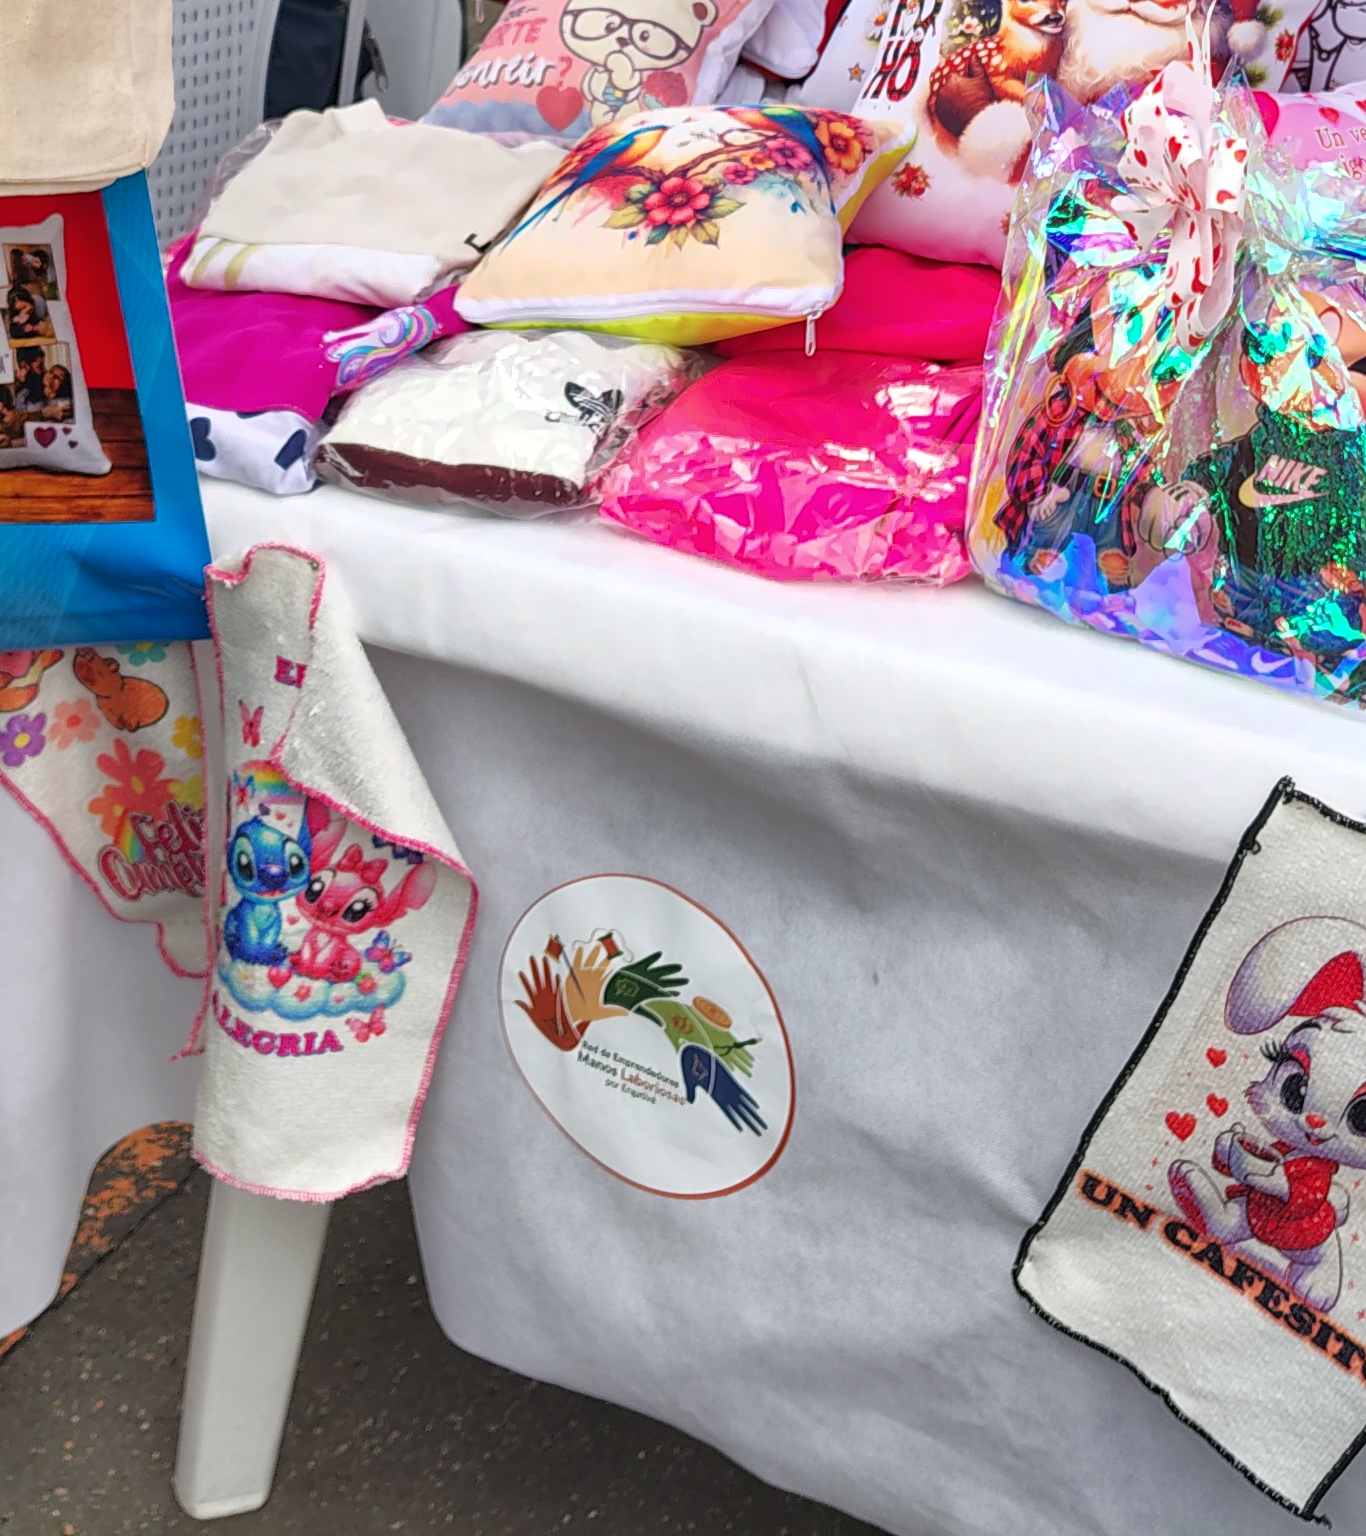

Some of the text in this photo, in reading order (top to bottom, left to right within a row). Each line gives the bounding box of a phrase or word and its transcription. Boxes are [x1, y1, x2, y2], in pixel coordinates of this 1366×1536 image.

[1314, 127, 1346, 150] Un
[1256, 453, 1328, 498] NIKE
[577, 1049, 618, 1077] Manos
[1078, 1170, 1161, 1232] UN
